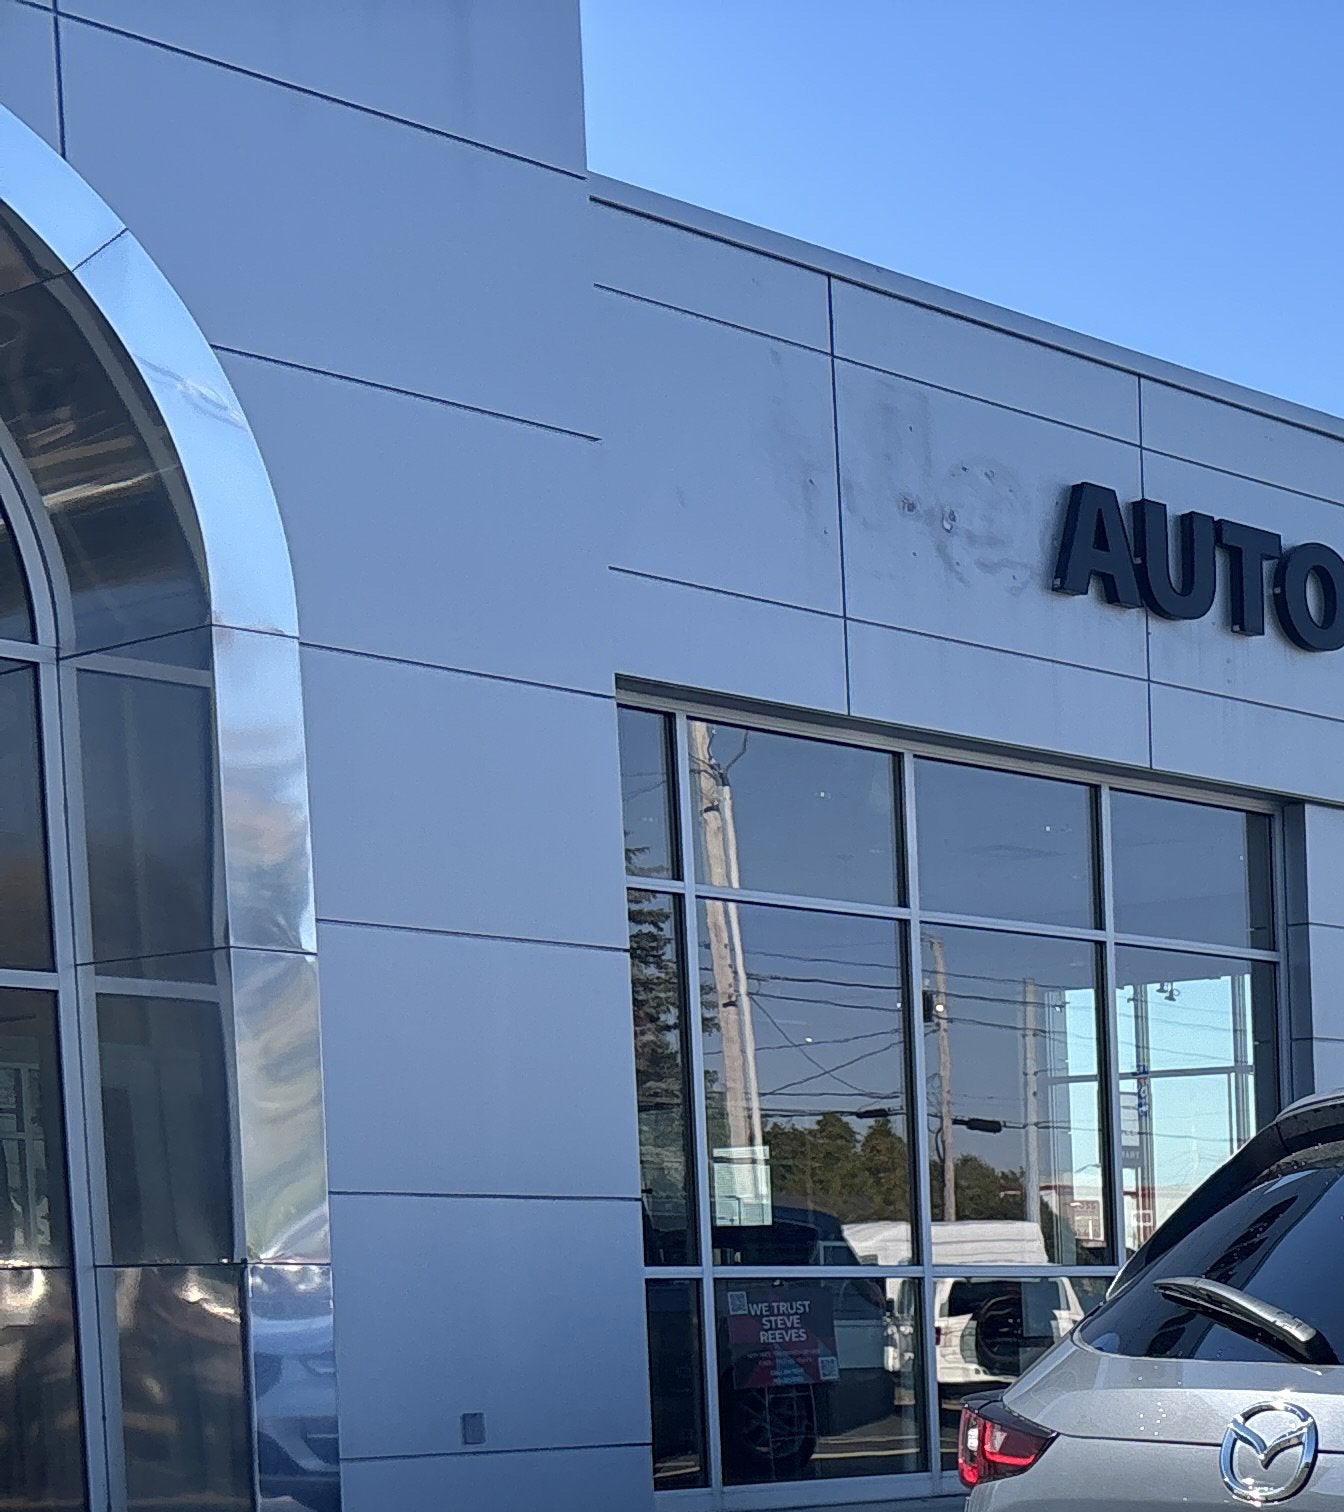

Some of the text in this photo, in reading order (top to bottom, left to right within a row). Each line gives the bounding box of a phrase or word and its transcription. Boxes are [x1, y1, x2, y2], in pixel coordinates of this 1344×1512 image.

[748, 1300, 811, 1316] WE TRUST
[761, 1315, 802, 1330] STEVE
[760, 1328, 807, 1343] REEVES
